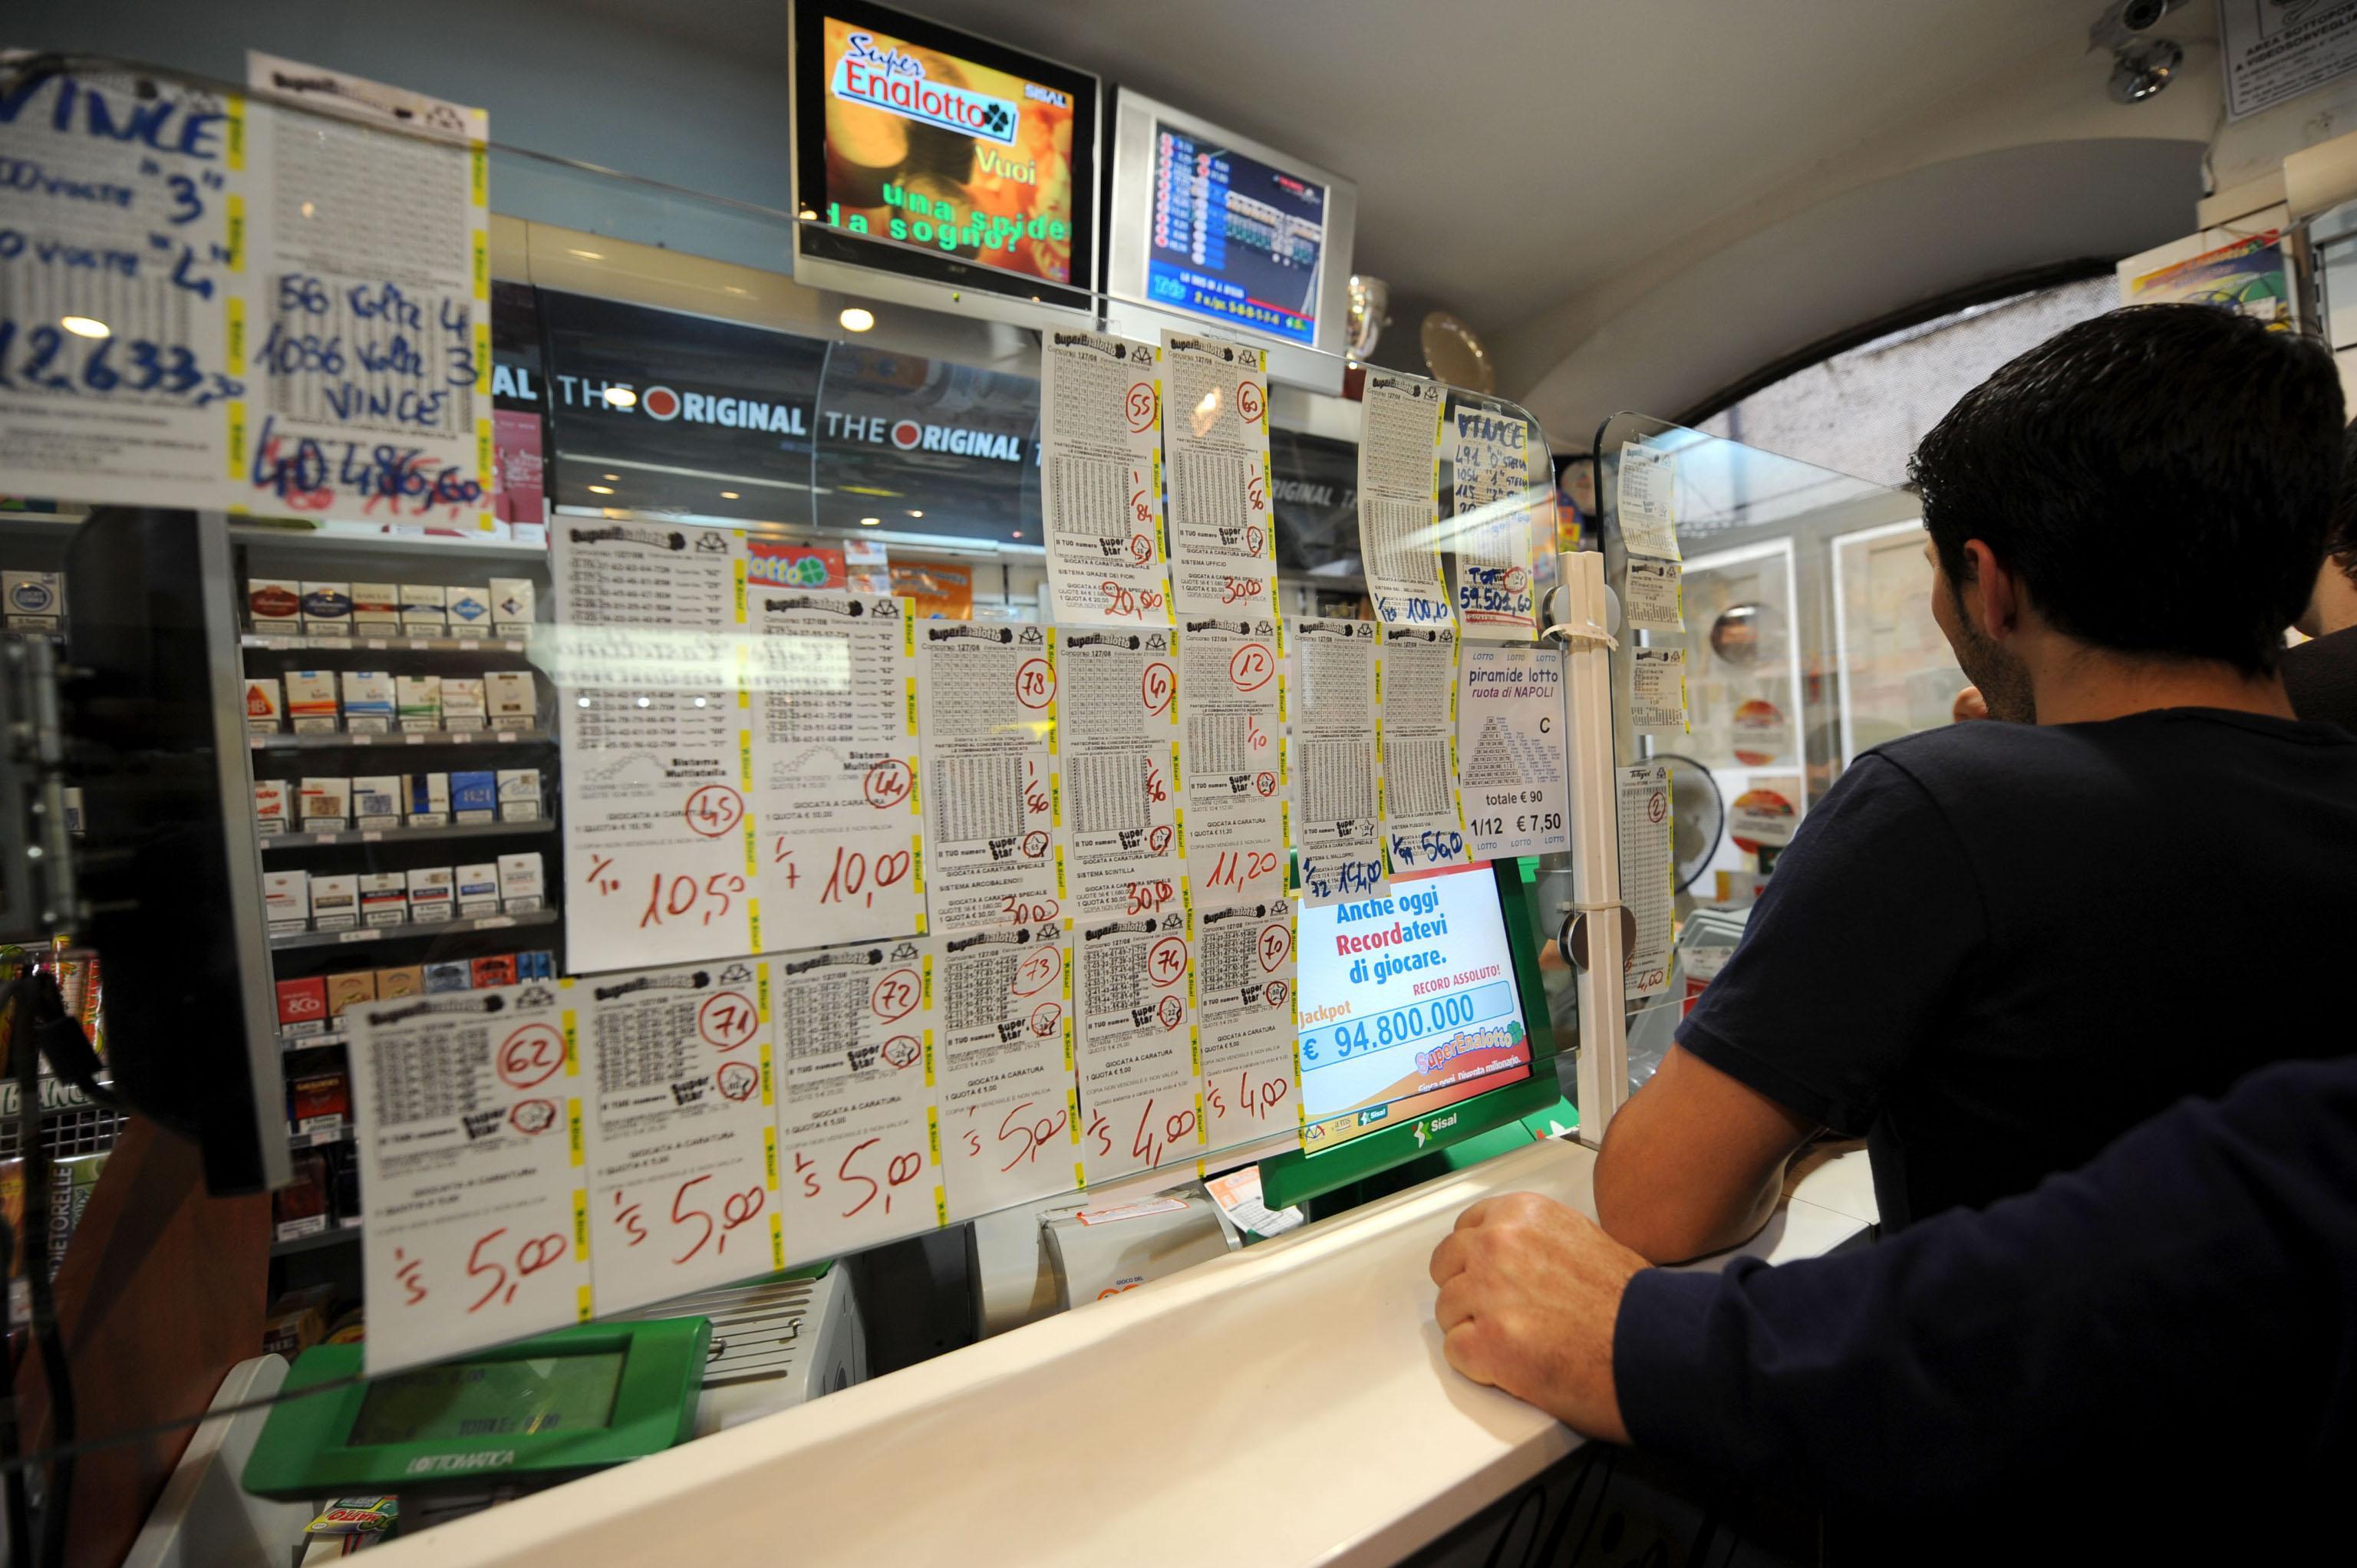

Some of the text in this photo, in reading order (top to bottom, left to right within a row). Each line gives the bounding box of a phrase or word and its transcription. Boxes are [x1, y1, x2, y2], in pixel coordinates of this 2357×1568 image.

[848, 34, 925, 78] Super
[844, 59, 987, 128] Enalotto
[975, 145, 1037, 186] Vuoi
[882, 182, 1073, 242] una spide
[890, 216, 1023, 253] sogno?
[439, 298, 468, 342] 4
[1054, 333, 1117, 357] SuperEnalotto
[1170, 338, 1225, 359] SuperEnalotto
[445, 348, 479, 387] 3
[324, 381, 449, 426] VINCE
[1131, 394, 1151, 417] 55
[825, 410, 886, 444] THE
[1218, 527, 1241, 535] Super
[1099, 538, 1125, 547] Super
[929, 624, 1002, 643] SuperEnalotto
[1187, 619, 1241, 634] SuperEnalotto
[1067, 633, 1130, 649] SuperEnalotto
[1239, 654, 1264, 677] 12
[1022, 671, 1044, 697] 78
[1469, 667, 1558, 686] piramide lotto
[1472, 687, 1553, 697] ruota di NAPOLI
[1540, 717, 1551, 733] C
[1229, 775, 1251, 785] Super
[1231, 783, 1248, 793] Star
[1485, 791, 1543, 805] totale € 90
[1337, 820, 1355, 830] Super
[1471, 812, 1561, 836] 1/12 € 7,50
[988, 837, 1017, 851] Super
[1119, 828, 1143, 842] Super
[1122, 840, 1140, 850] Star
[1477, 835, 1564, 850] LOTTO LOTTO LOTTO
[992, 848, 1013, 861] Star
[982, 865, 1015, 874] CARATURA
[1206, 851, 1277, 893] 11,20
[940, 882, 970, 891] SISTEMA
[1336, 884, 1440, 924] Anche oggi
[1203, 906, 1258, 924] SuperEnalotto
[1085, 921, 1148, 941] SuperEnalotto
[1336, 913, 1449, 957] Recordatevi
[947, 932, 1019, 953] SuperEnalotto
[1024, 958, 1050, 981] 73
[1350, 949, 1447, 985] di giocare.
[1413, 964, 1502, 996] RECORD ASSOLUTO!
[882, 981, 911, 1010] 72
[1241, 984, 1263, 997] Super
[1244, 994, 1259, 1006] Star
[1132, 1004, 1156, 1018] Super
[1299, 1000, 1352, 1029] Jackpot
[998, 1019, 1027, 1033] Super
[1134, 1015, 1152, 1028] Star
[1303, 993, 1475, 1061] € 94.800.000
[1217, 1026, 1276, 1043] GIOCATA CARATURA
[505, 1039, 555, 1073] 62
[1205, 1044, 1224, 1053] QUOTA
[1416, 1026, 1513, 1077] SuperEnalotto
[1106, 1049, 1173, 1069] GIOCATA CARATURA
[968, 1066, 1044, 1087] GIOCATA CARATURA
[1091, 1069, 1113, 1081] QUOTA
[1241, 1072, 1287, 1120] 4,00
[1370, 1108, 1386, 1119] Sisal
[1431, 1113, 1458, 1133] Sisal
[1132, 1098, 1195, 1170] 4,00
[406, 1449, 516, 1474] LOTTOMATICA
